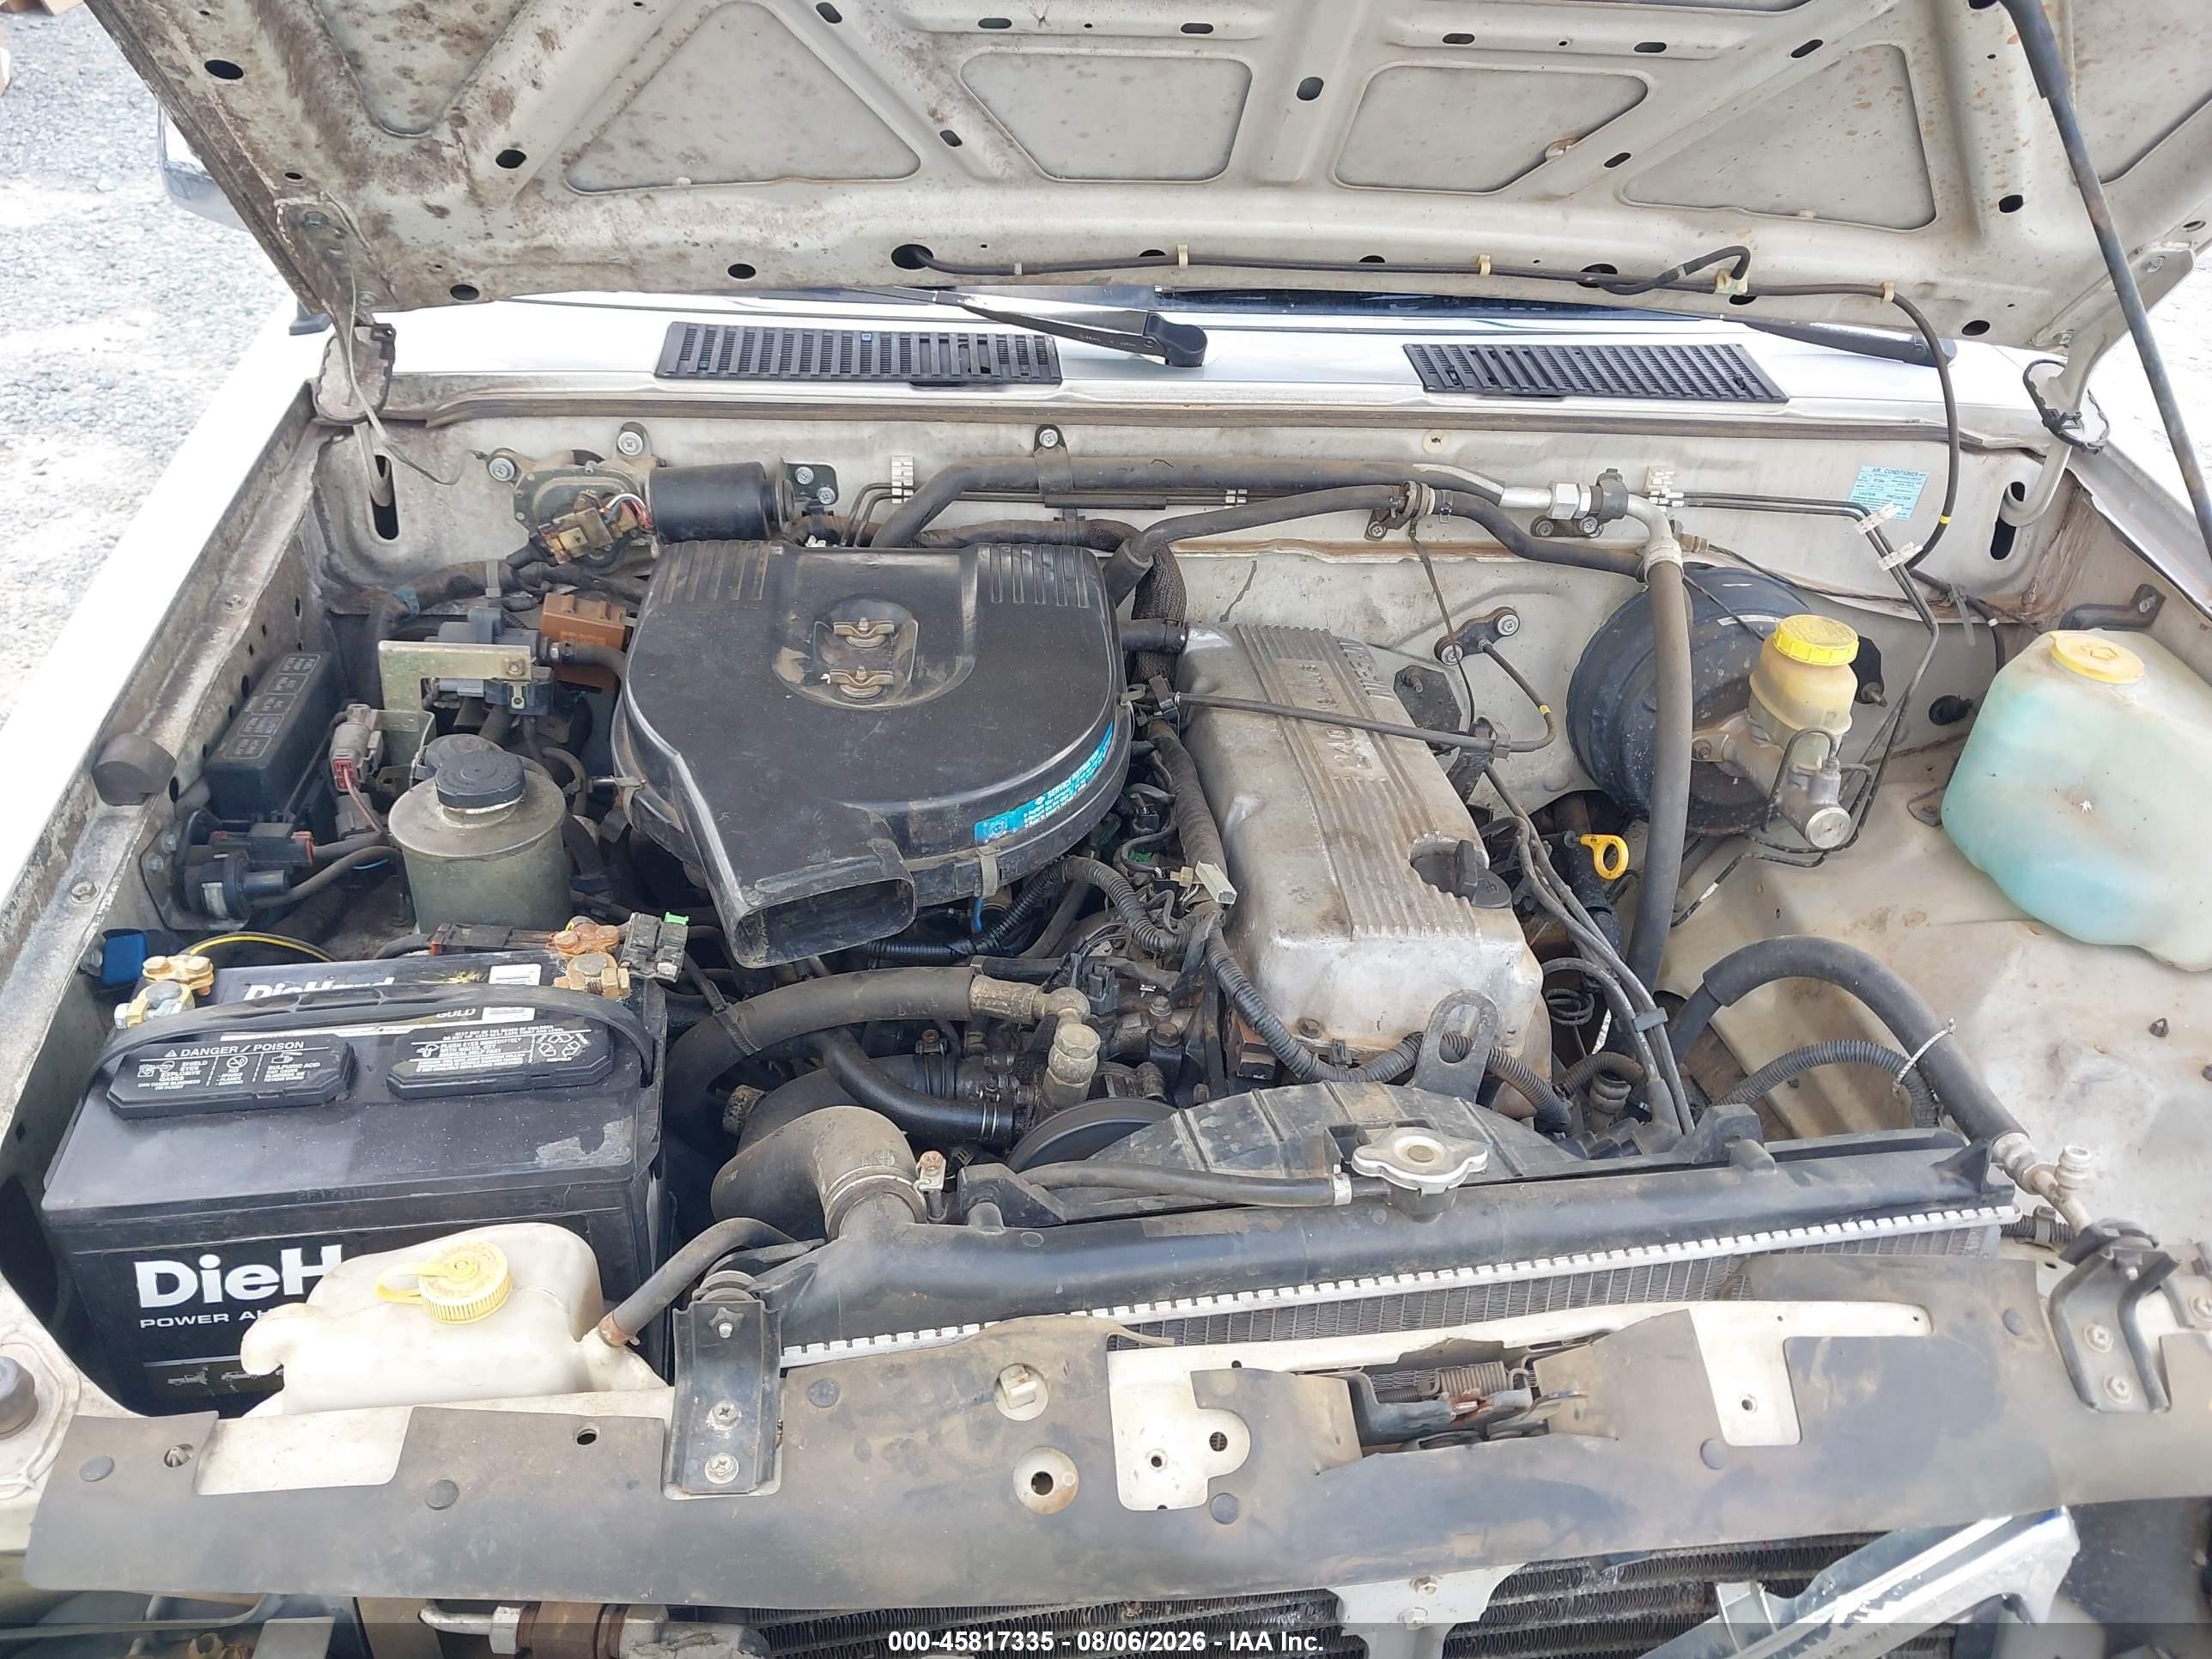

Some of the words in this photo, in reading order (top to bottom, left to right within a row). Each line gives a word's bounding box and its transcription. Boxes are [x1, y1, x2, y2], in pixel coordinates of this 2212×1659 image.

[180, 1046, 239, 1057] DANGER
[253, 1042, 304, 1051] POISON
[134, 1244, 343, 1308] DieH
[139, 1312, 230, 1328] POWER
